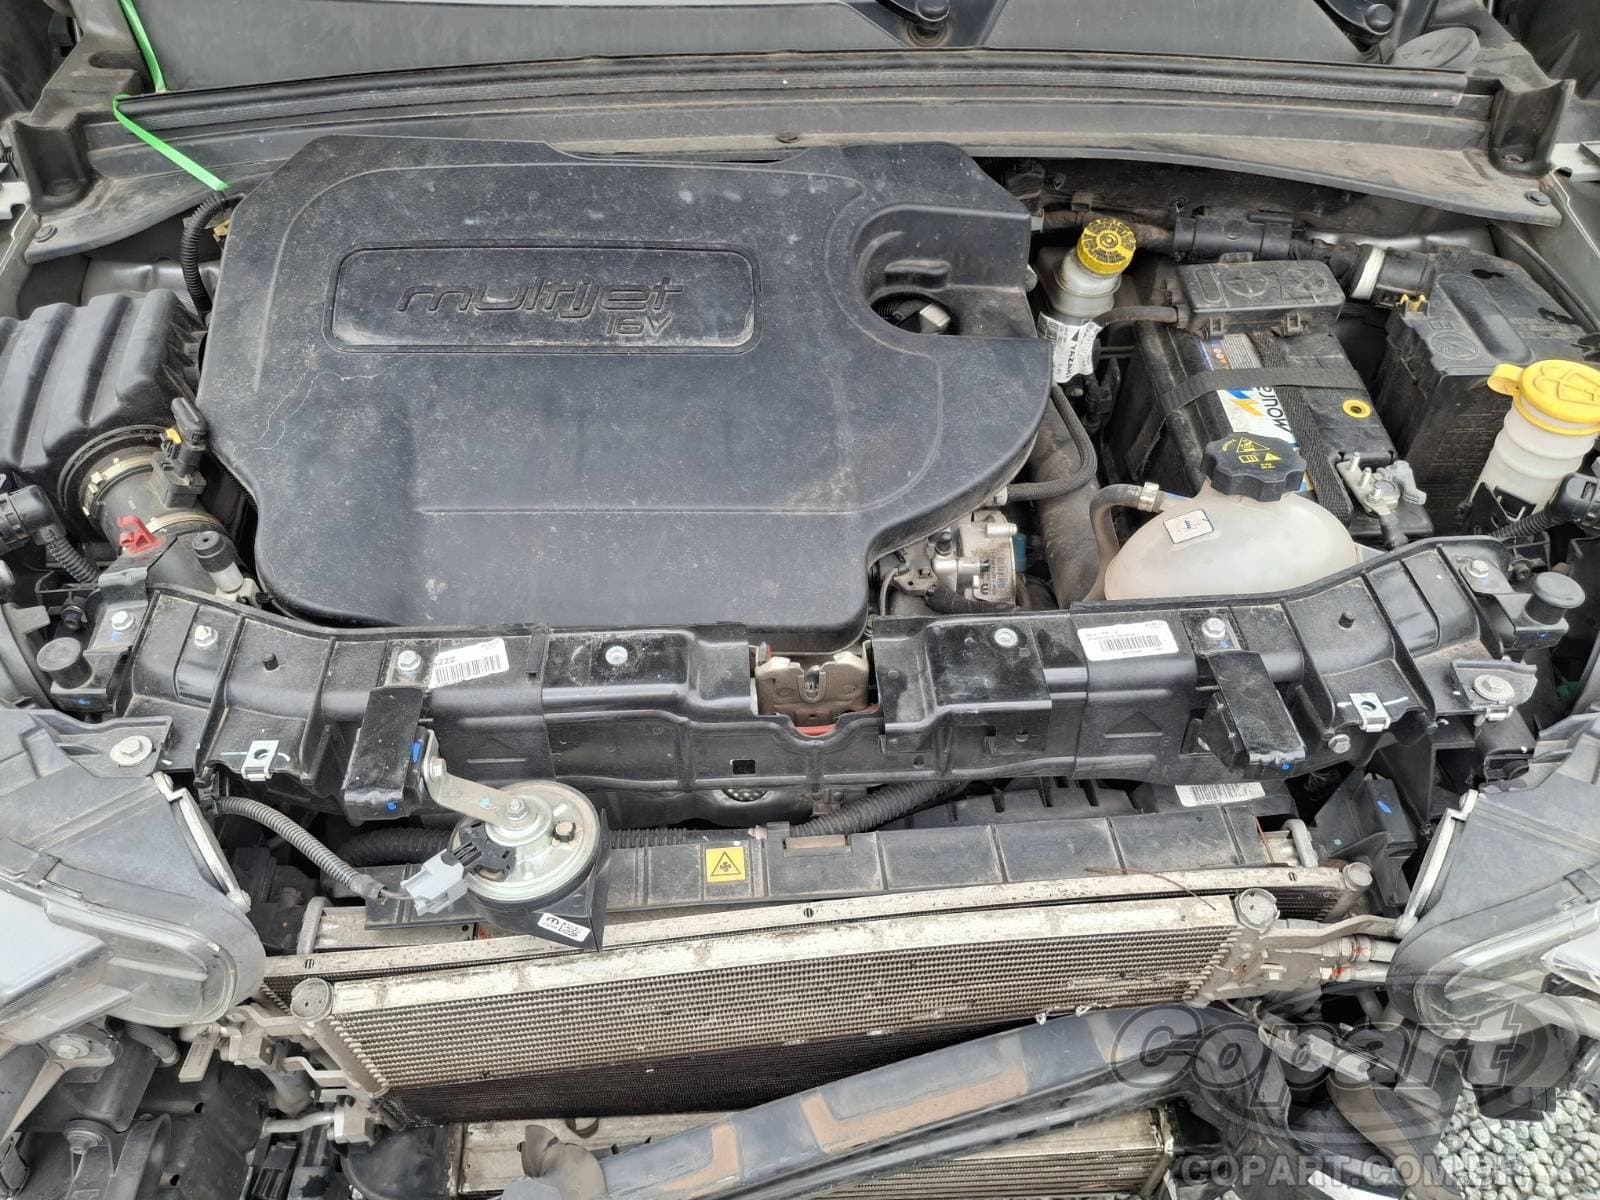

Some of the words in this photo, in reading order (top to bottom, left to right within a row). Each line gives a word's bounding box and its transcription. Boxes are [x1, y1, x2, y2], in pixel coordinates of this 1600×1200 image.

[397, 276, 683, 318] multijet
[605, 315, 673, 336] 16V
[1065, 344, 1078, 379] YAZAKI
